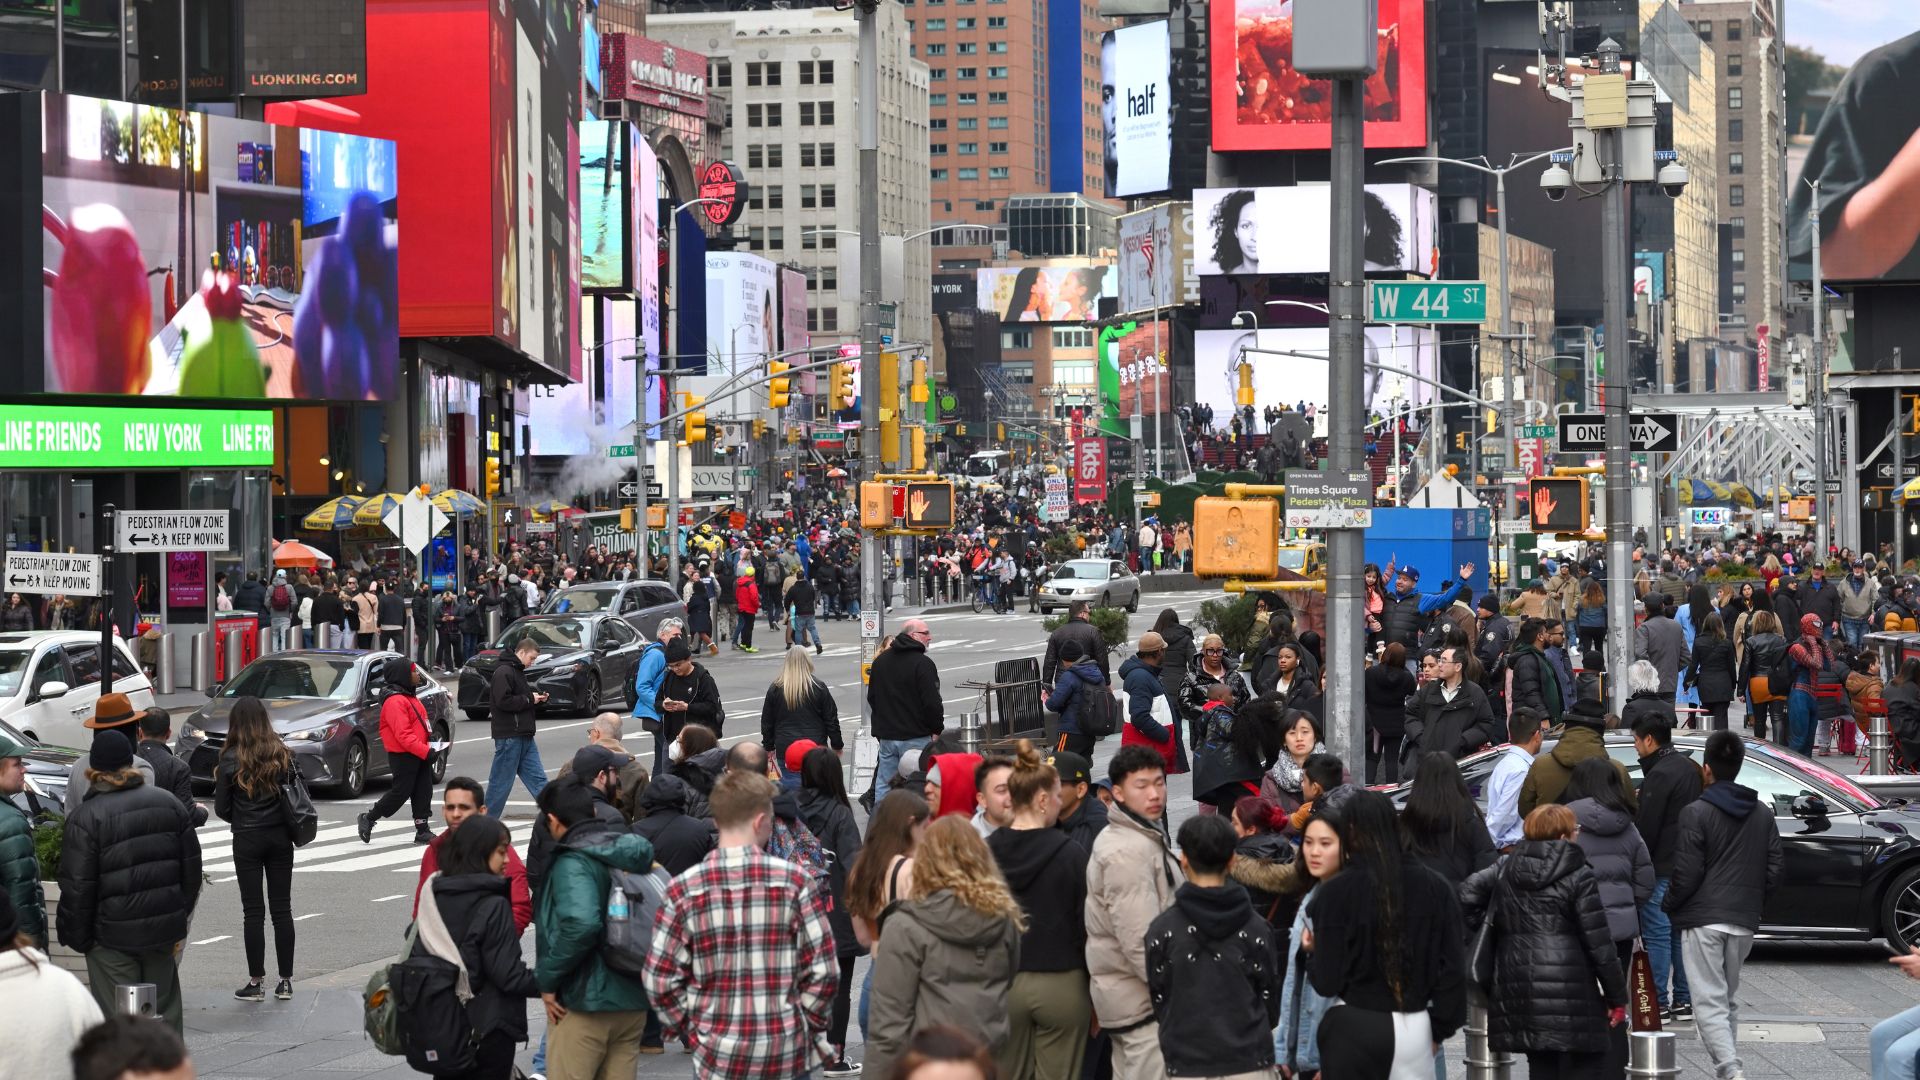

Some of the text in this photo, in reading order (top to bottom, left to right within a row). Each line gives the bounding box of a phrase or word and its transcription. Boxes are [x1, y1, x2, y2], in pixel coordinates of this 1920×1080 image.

[251, 73, 357, 86] LIONKING.COM
[1127, 83, 1156, 118] half
[941, 284, 962, 293] YORK
[1377, 287, 1480, 318] W 44 ST
[36, 421, 101, 452] FRIENDS
[124, 422, 160, 452] NEW
[163, 423, 202, 452] YORK
[223, 424, 252, 452] LINE
[1524, 427, 1532, 437] W
[1535, 427, 1545, 437] 45
[620, 447, 628, 455] 45
[1082, 440, 1101, 480] tkts
[1290, 485, 1358, 496] Times Square
[1342, 497, 1367, 506] Plaza
[128, 515, 224, 529] PEDESTRIAN FLOW ZONE
[171, 532, 224, 546] KEEP MOVING
[9, 557, 50, 571] PEDESTRIAN
[72, 560, 91, 573] ZONE
[62, 576, 90, 589] MOVING
